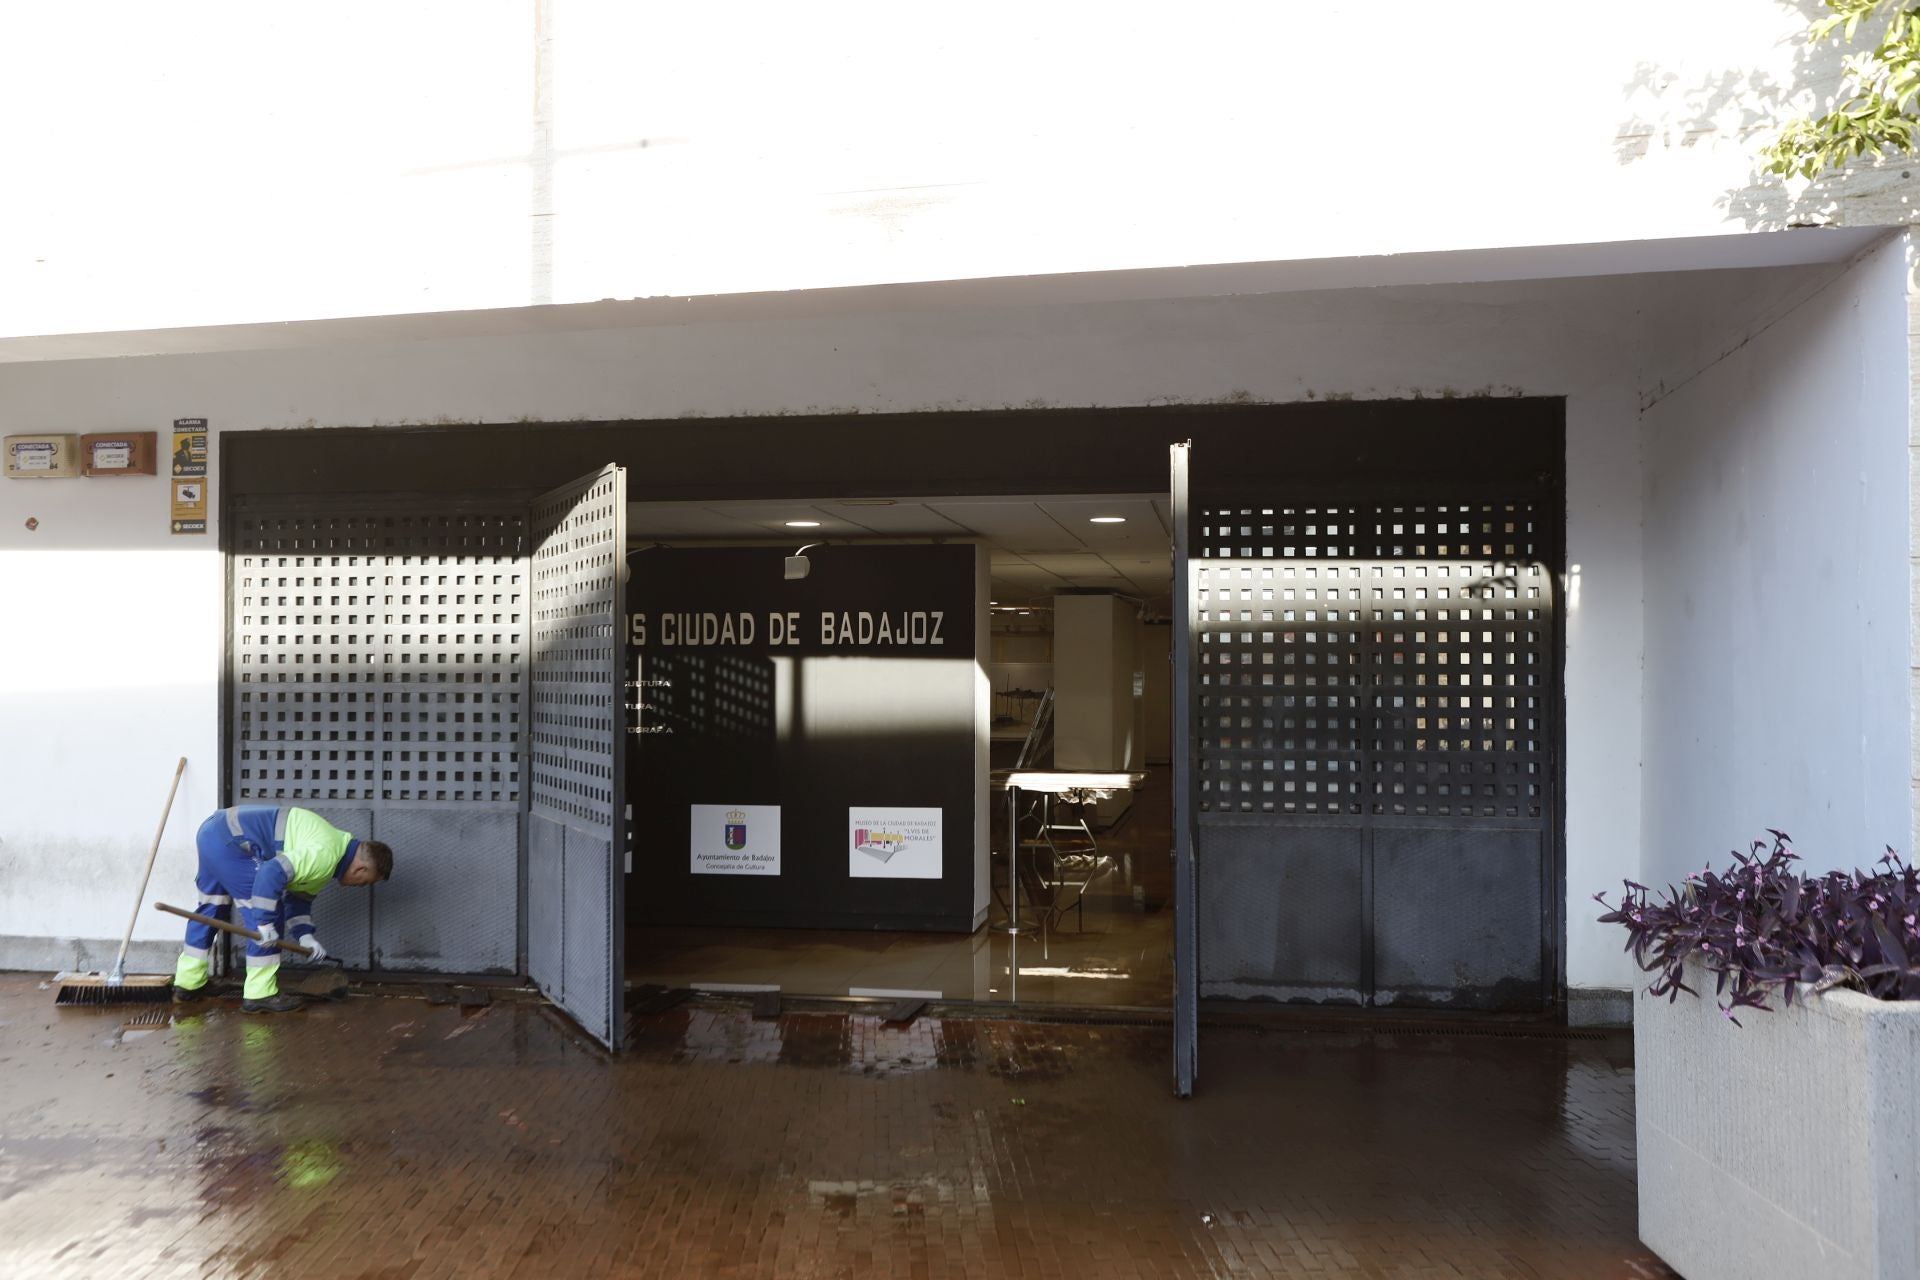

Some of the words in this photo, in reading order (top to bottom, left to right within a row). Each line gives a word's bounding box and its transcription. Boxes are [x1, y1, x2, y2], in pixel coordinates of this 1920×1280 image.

[625, 613, 646, 646] S
[661, 612, 755, 646] CIUDAD
[769, 612, 800, 645] DE
[821, 611, 944, 645] BADAJOZ
[697, 854, 740, 862] Ayuntamiento
[751, 854, 775, 863] Badajoz
